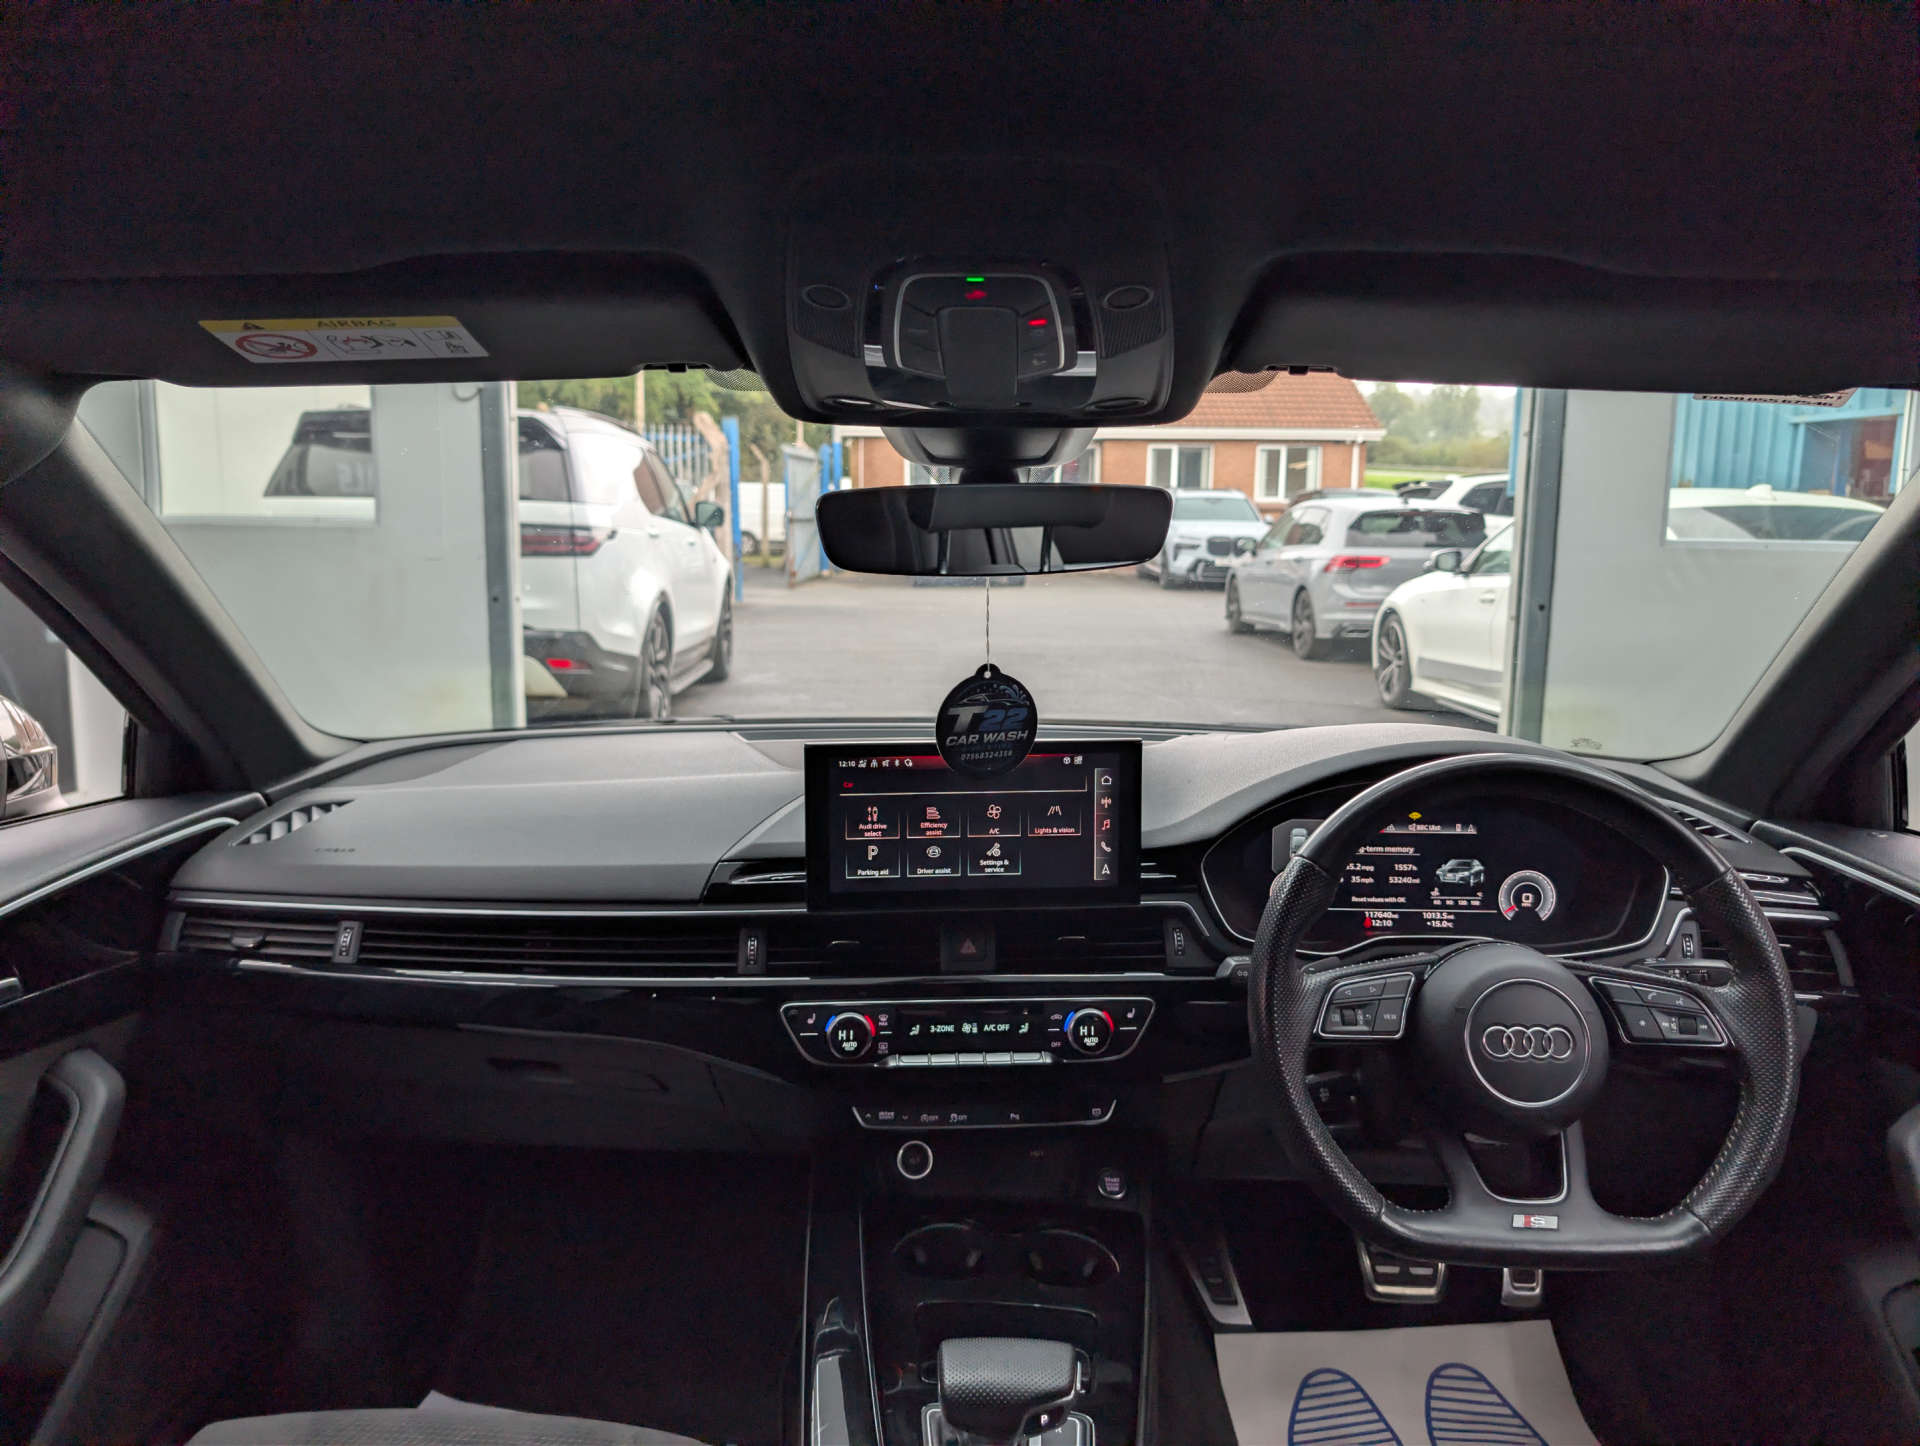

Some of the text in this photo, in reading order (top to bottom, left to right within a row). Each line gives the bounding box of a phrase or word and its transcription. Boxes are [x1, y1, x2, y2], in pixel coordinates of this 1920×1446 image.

[947, 705, 1029, 733] T22
[946, 735, 979, 747] CAR
[983, 730, 1029, 743] WASH
[839, 760, 856, 768] 12:10
[1034, 827, 1052, 835] Lights
[980, 859, 1003, 867] Settings
[857, 869, 879, 877] Parking
[1371, 919, 1393, 927] 12:10
[930, 1024, 955, 1033] 3-ZONE
[983, 1023, 1010, 1032] A/C OFF
[1041, 1414, 1048, 1425] P
